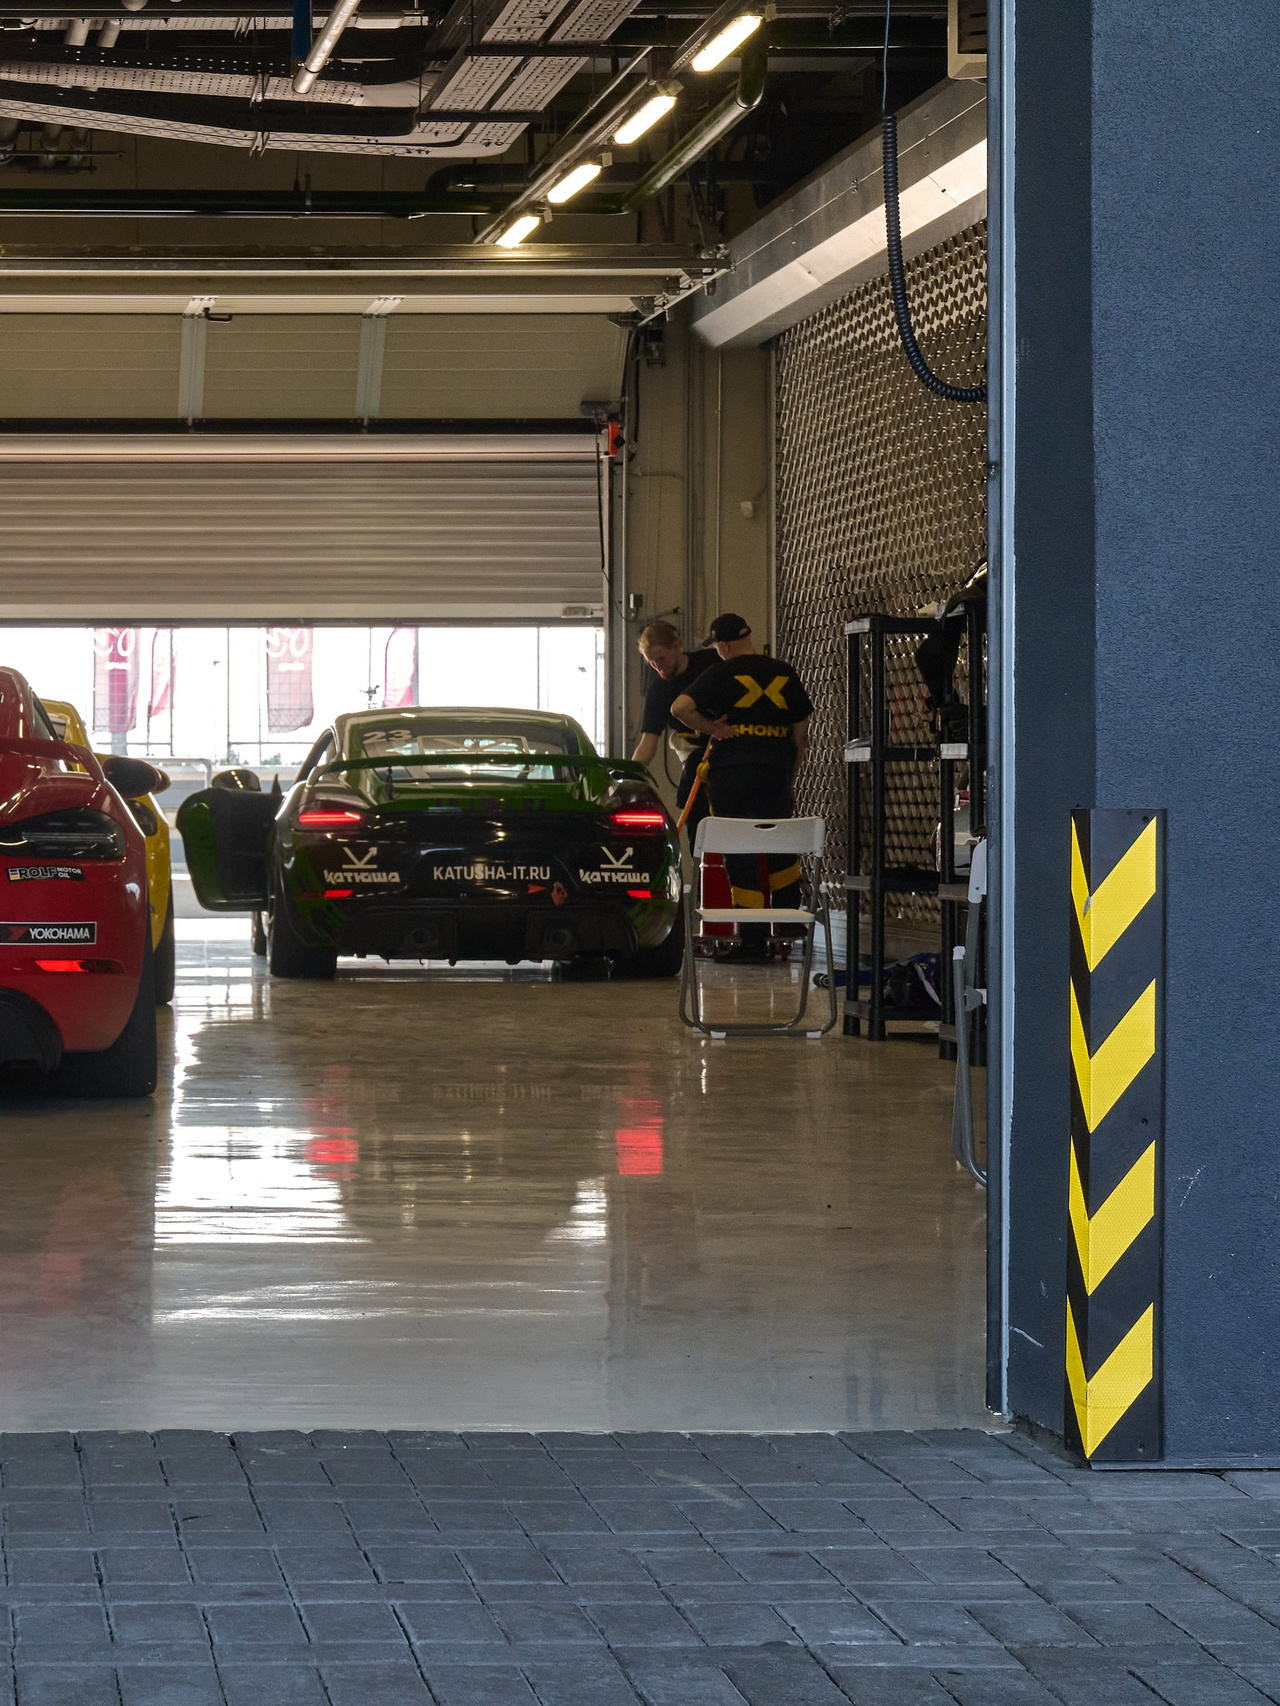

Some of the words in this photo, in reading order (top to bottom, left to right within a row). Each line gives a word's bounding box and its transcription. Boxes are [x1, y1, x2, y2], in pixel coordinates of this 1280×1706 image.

[363, 729, 412, 744] 23
[18, 866, 57, 879] ROLF
[56, 866, 82, 875] MOTOR
[433, 865, 551, 881] KATUSHA-IT.RU
[29, 927, 90, 940] YOKOHAMA
